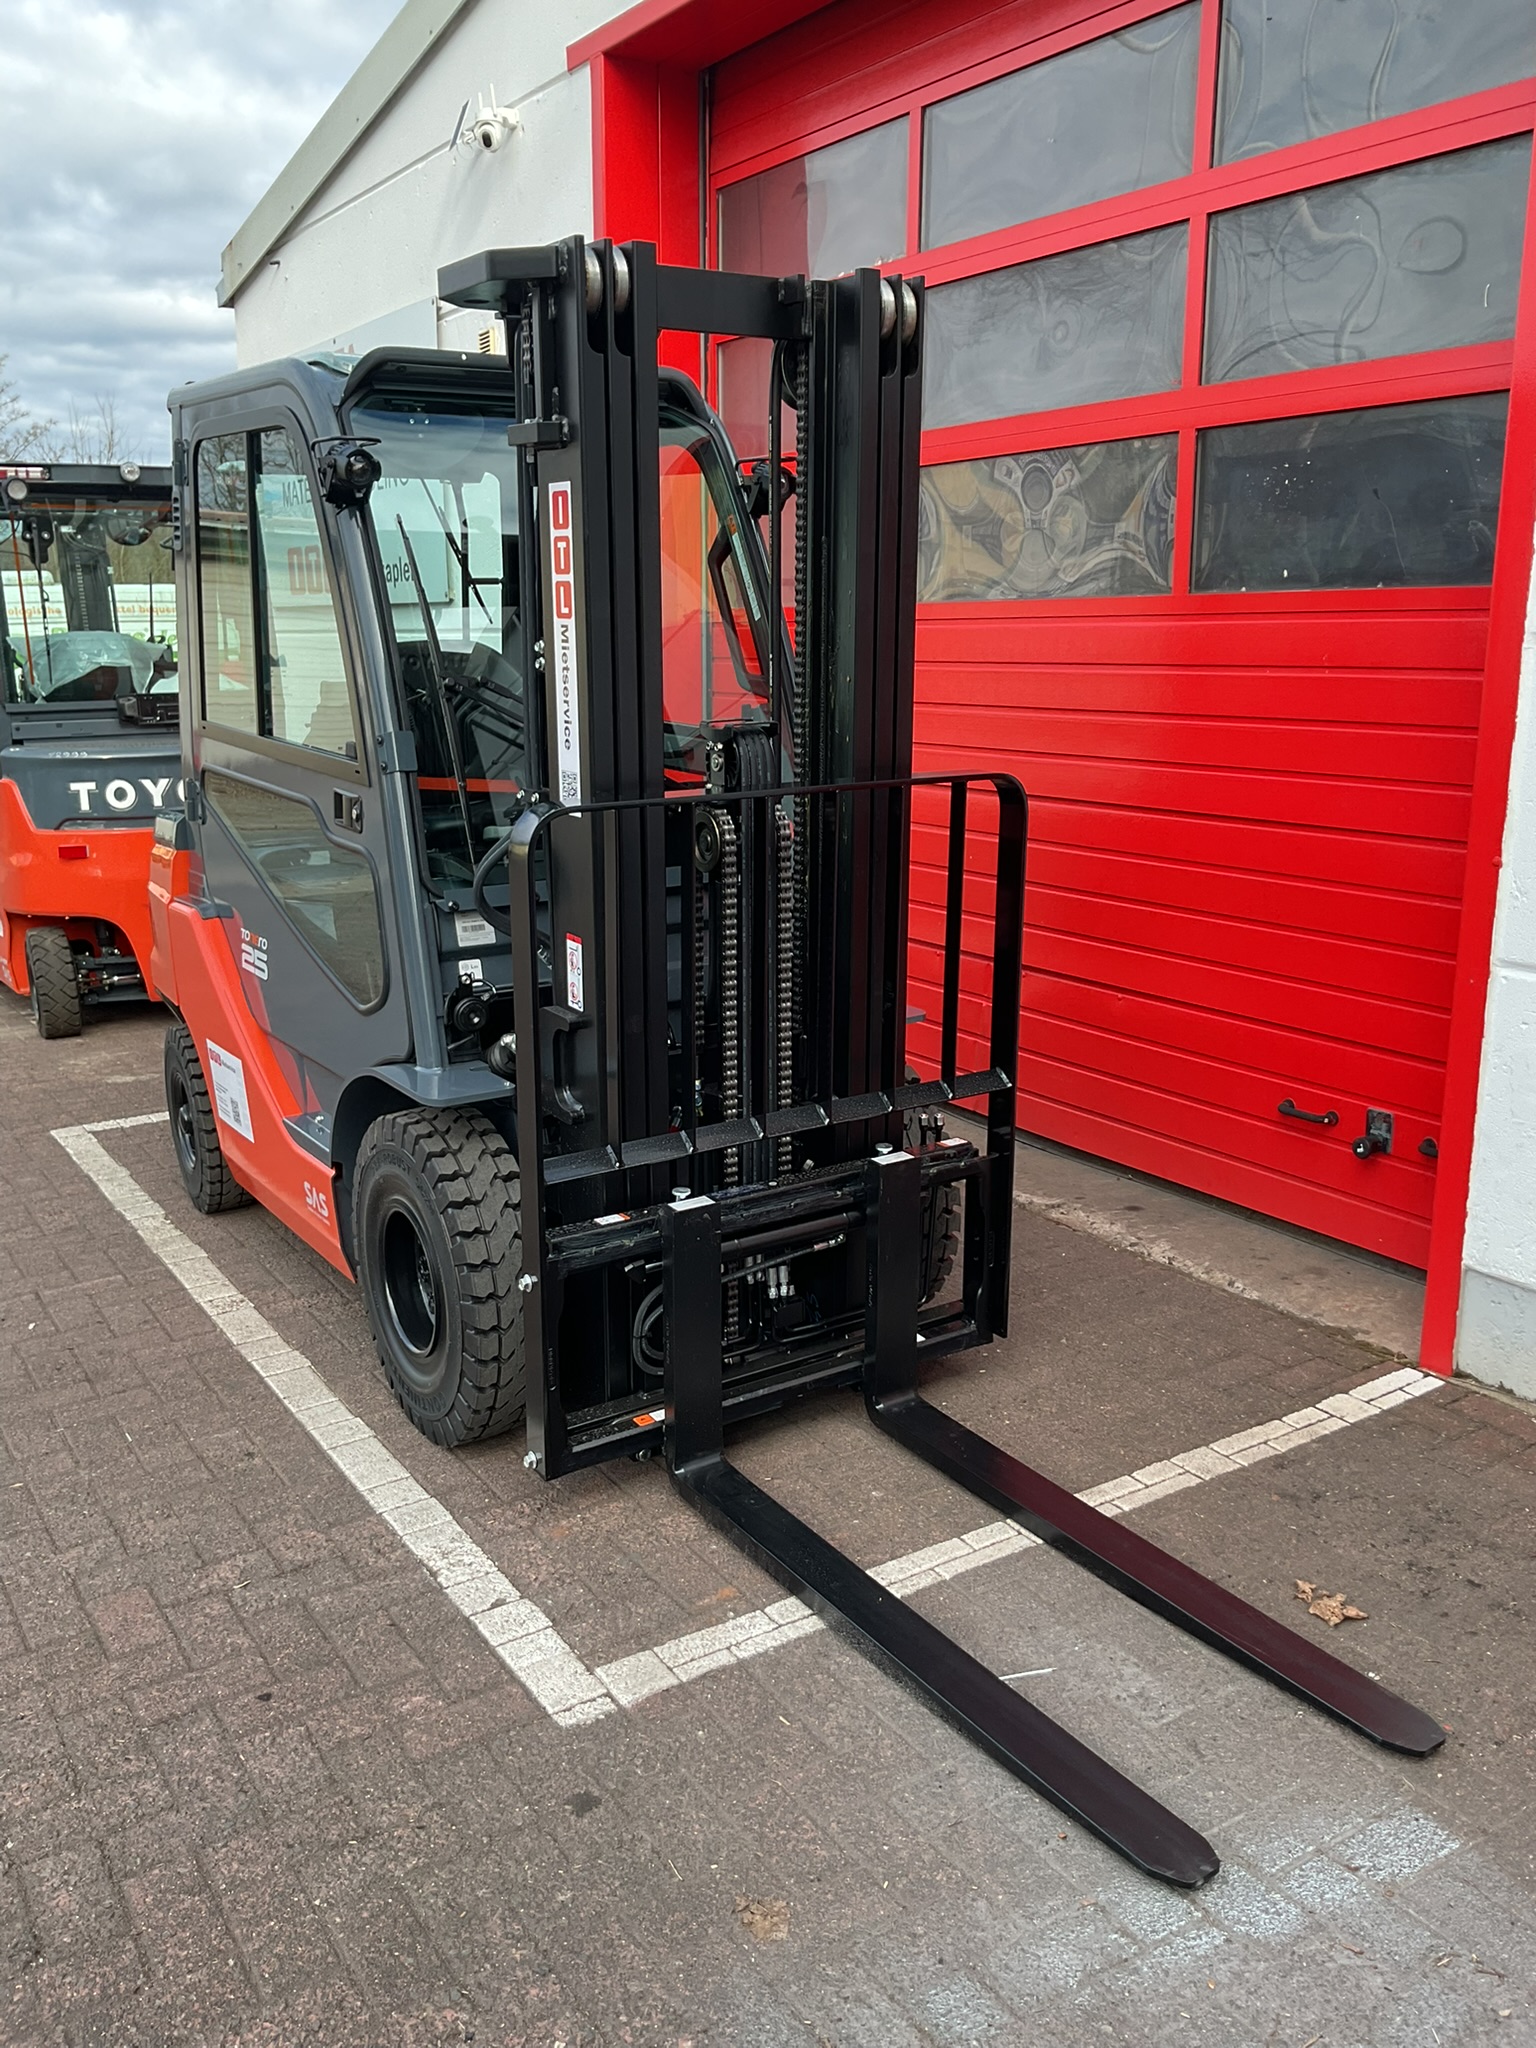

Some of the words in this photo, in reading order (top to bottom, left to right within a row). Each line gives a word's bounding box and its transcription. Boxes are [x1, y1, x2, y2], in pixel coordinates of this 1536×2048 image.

[559, 623, 573, 751] Mietservice
[69, 777, 186, 812] TOY
[241, 942, 269, 981] 25
[303, 1181, 329, 1218] SAS
